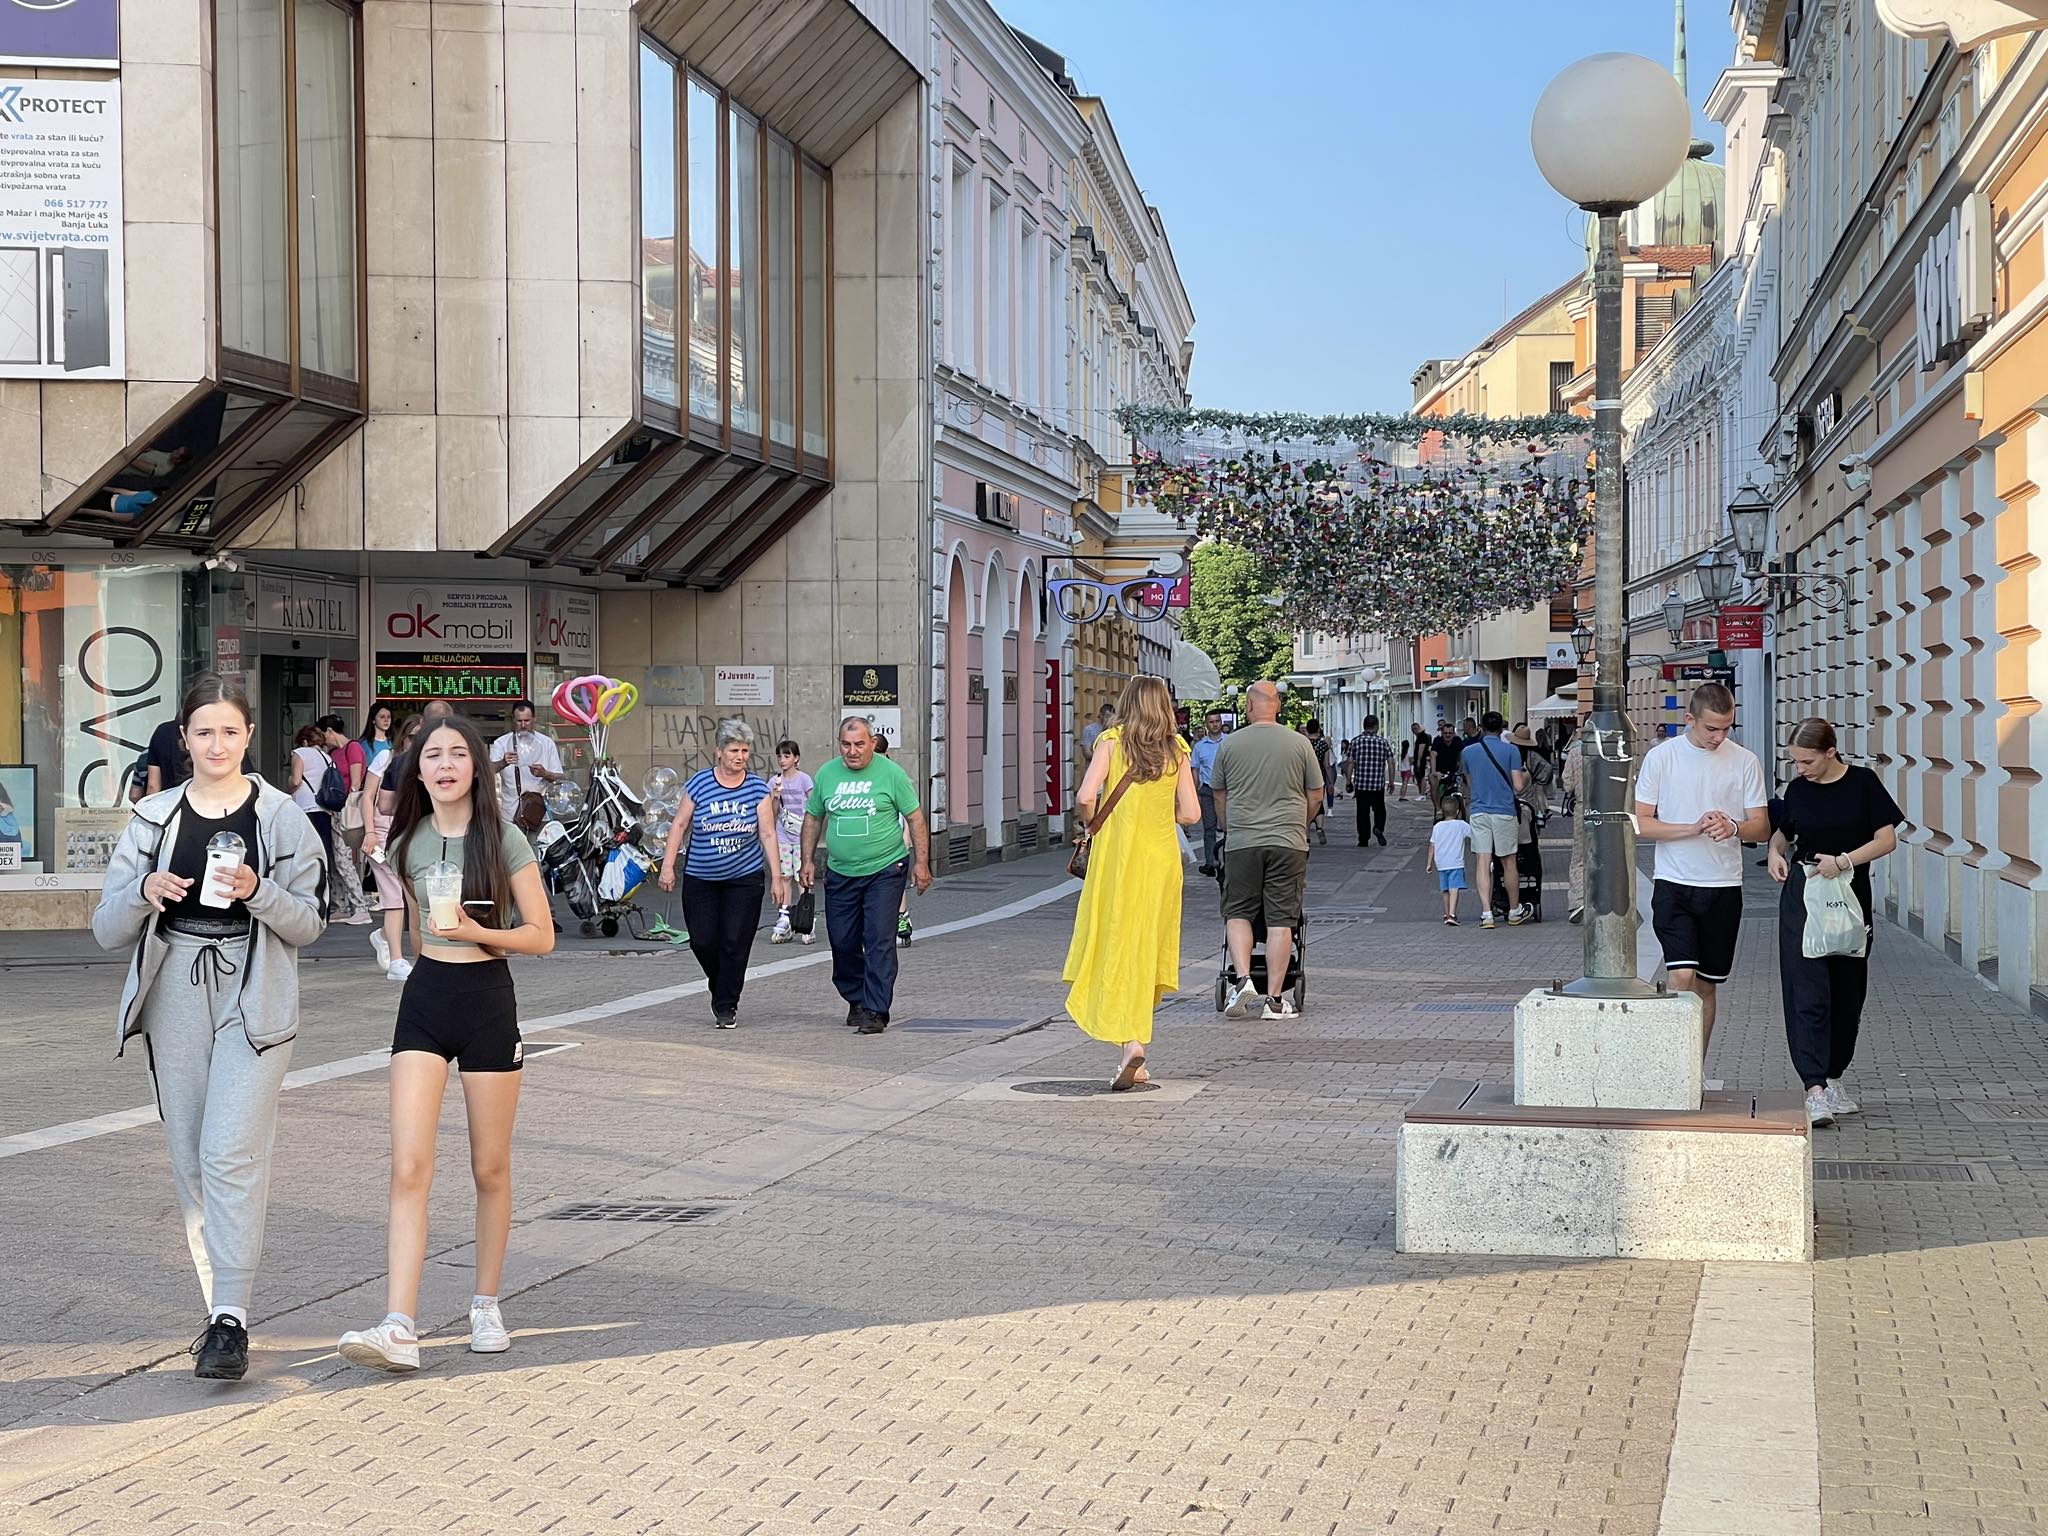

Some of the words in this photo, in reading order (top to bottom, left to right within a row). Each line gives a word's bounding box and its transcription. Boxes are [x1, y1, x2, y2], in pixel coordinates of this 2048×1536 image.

[20, 98, 107, 114] PROTECT
[79, 134, 104, 142] kuću?
[82, 161, 102, 169] kuću
[44, 199, 64, 208] 066
[66, 199, 86, 208] 517
[89, 200, 108, 209] 777
[6, 209, 32, 217] Mažar
[39, 210, 66, 219] majke
[68, 211, 96, 220] Marije
[61, 220, 86, 230] Banja
[88, 221, 109, 229] Luka
[0, 230, 109, 243] w.svijetvrata.com
[31, 552, 56, 563] OVS
[110, 552, 135, 563] OVS
[475, 593, 508, 601] PRODAJA
[1151, 593, 1182, 601] MOILE
[441, 601, 477, 609] MOBILNIH
[282, 594, 347, 632] KASTEL
[422, 654, 481, 664] MJENJAČNICA
[376, 670, 521, 695] MJENJAČNICA
[710, 800, 748, 817] MAKE
[828, 794, 876, 812] Celtics
[34, 876, 59, 887] OVS
